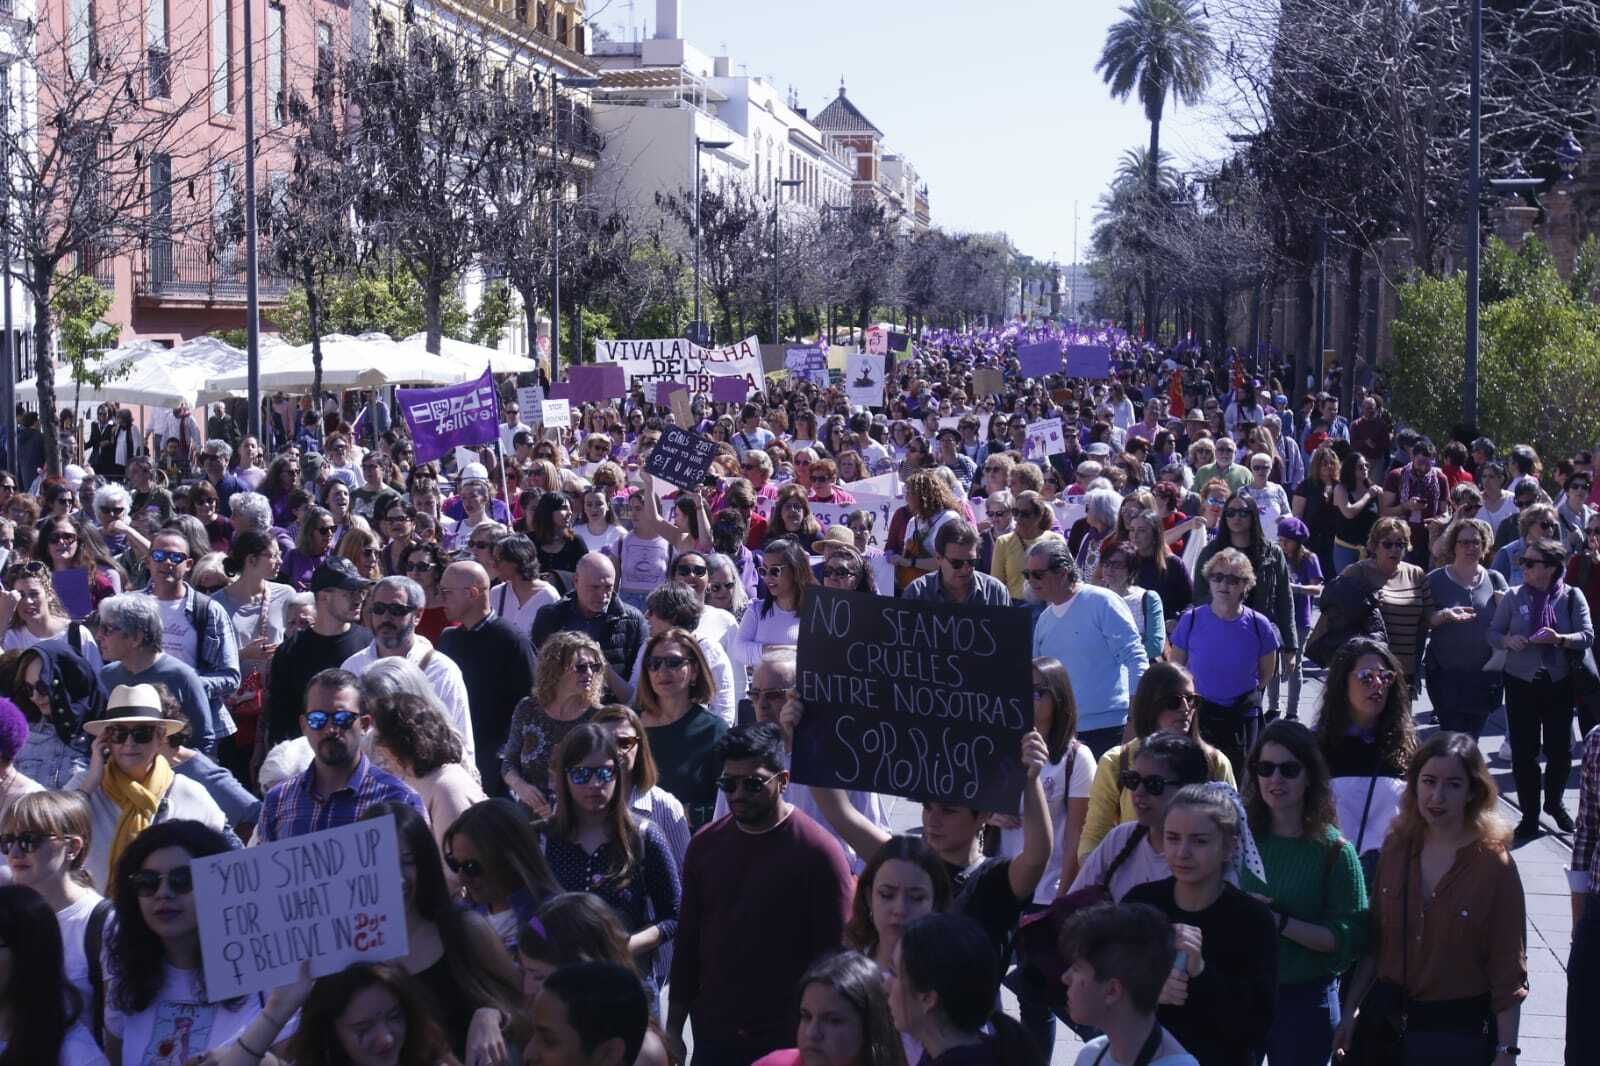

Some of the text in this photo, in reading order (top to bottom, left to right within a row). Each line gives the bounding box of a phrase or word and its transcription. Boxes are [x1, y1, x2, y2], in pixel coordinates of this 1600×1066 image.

[604, 341, 656, 361] VIVA
[660, 340, 682, 360] LA
[653, 359, 680, 375] DE
[811, 596, 997, 657] NO SEAMOS
[847, 641, 964, 688] CRUELES
[802, 671, 1025, 730] ENTRE NOSOTRAS
[271, 838, 345, 889] STAND
[354, 828, 381, 869] UP
[222, 872, 380, 937] FOR WHAT YOU
[250, 922, 327, 973] BELIEVE
[331, 917, 353, 951] IN
